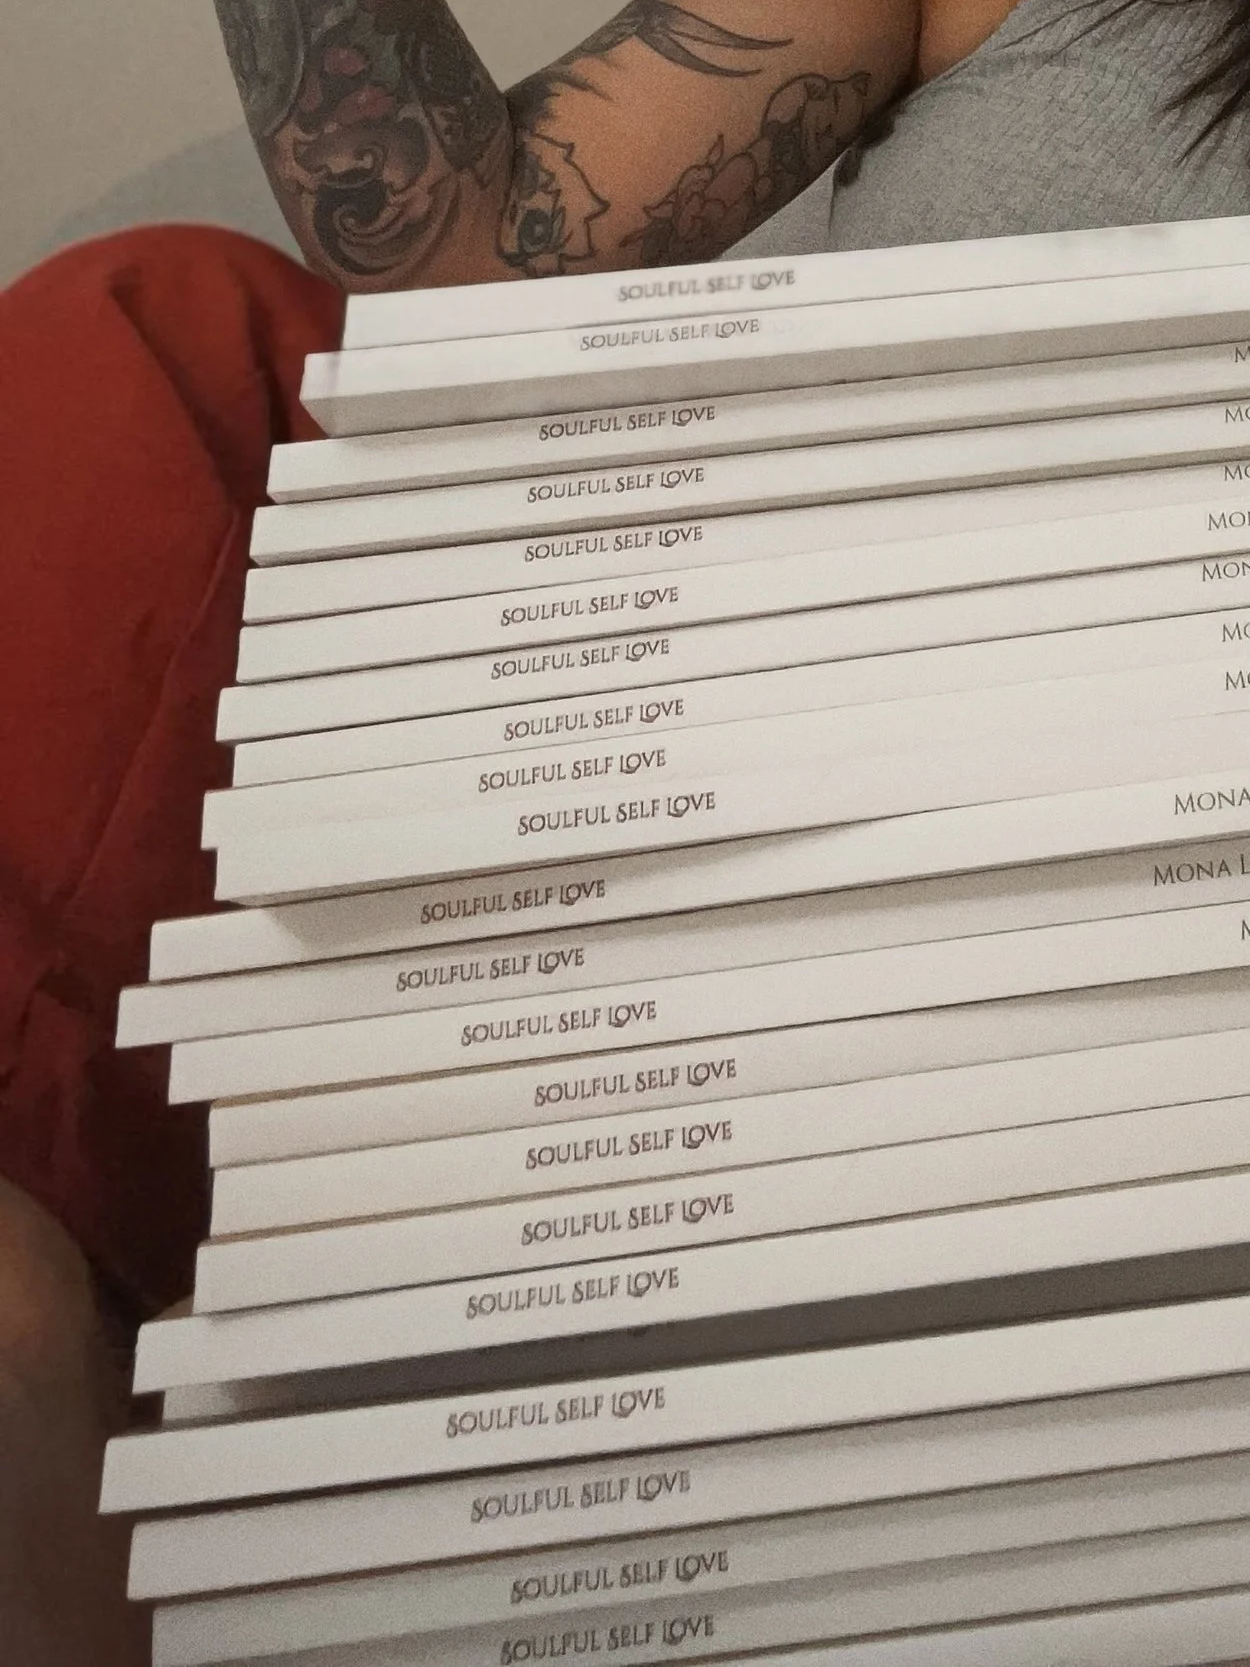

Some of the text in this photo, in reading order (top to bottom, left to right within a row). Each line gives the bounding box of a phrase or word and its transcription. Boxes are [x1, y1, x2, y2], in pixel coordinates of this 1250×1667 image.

[618, 269, 795, 302] SOULFUL SELF LOVE
[580, 319, 760, 352] SOULFUL SELF LOVE
[539, 406, 715, 441] SOULFUL SELF LOVE
[527, 467, 704, 503] SOULFUL SELF LOVE
[525, 526, 703, 562] SOULFUL SELF LOVE
[500, 586, 678, 627] SOULFUL SELF LOVE
[491, 638, 669, 680] SOULFUL SELF LOVE
[504, 699, 684, 741] SOULFUL SELF LOVE
[478, 749, 666, 793] SOULFUL SELF LOVE
[518, 792, 715, 836] SOULFUL SELF LOVE
[1154, 859, 1232, 886] MONA
[421, 879, 605, 925] SOULFUL SELF LOVE
[396, 947, 584, 993] SOULFUL SELF LOVE
[461, 1001, 656, 1047] SOULFUL SELF LOVE
[534, 1058, 736, 1107] SOULFUL SELF LOVE
[526, 1120, 732, 1170] SOULFUL SELF LOVE
[521, 1194, 734, 1246] SOULFUL SELF LOVE
[466, 1267, 679, 1320] SOULFUL SELF LOVE
[446, 1386, 665, 1439] SOULFUL SELF LOVE
[471, 1470, 690, 1524] SOULFUL SELF LOVE
[511, 1550, 729, 1604] SOULFUL SELF LOVE
[500, 1614, 715, 1666] SOULFUL SELF LOVE
